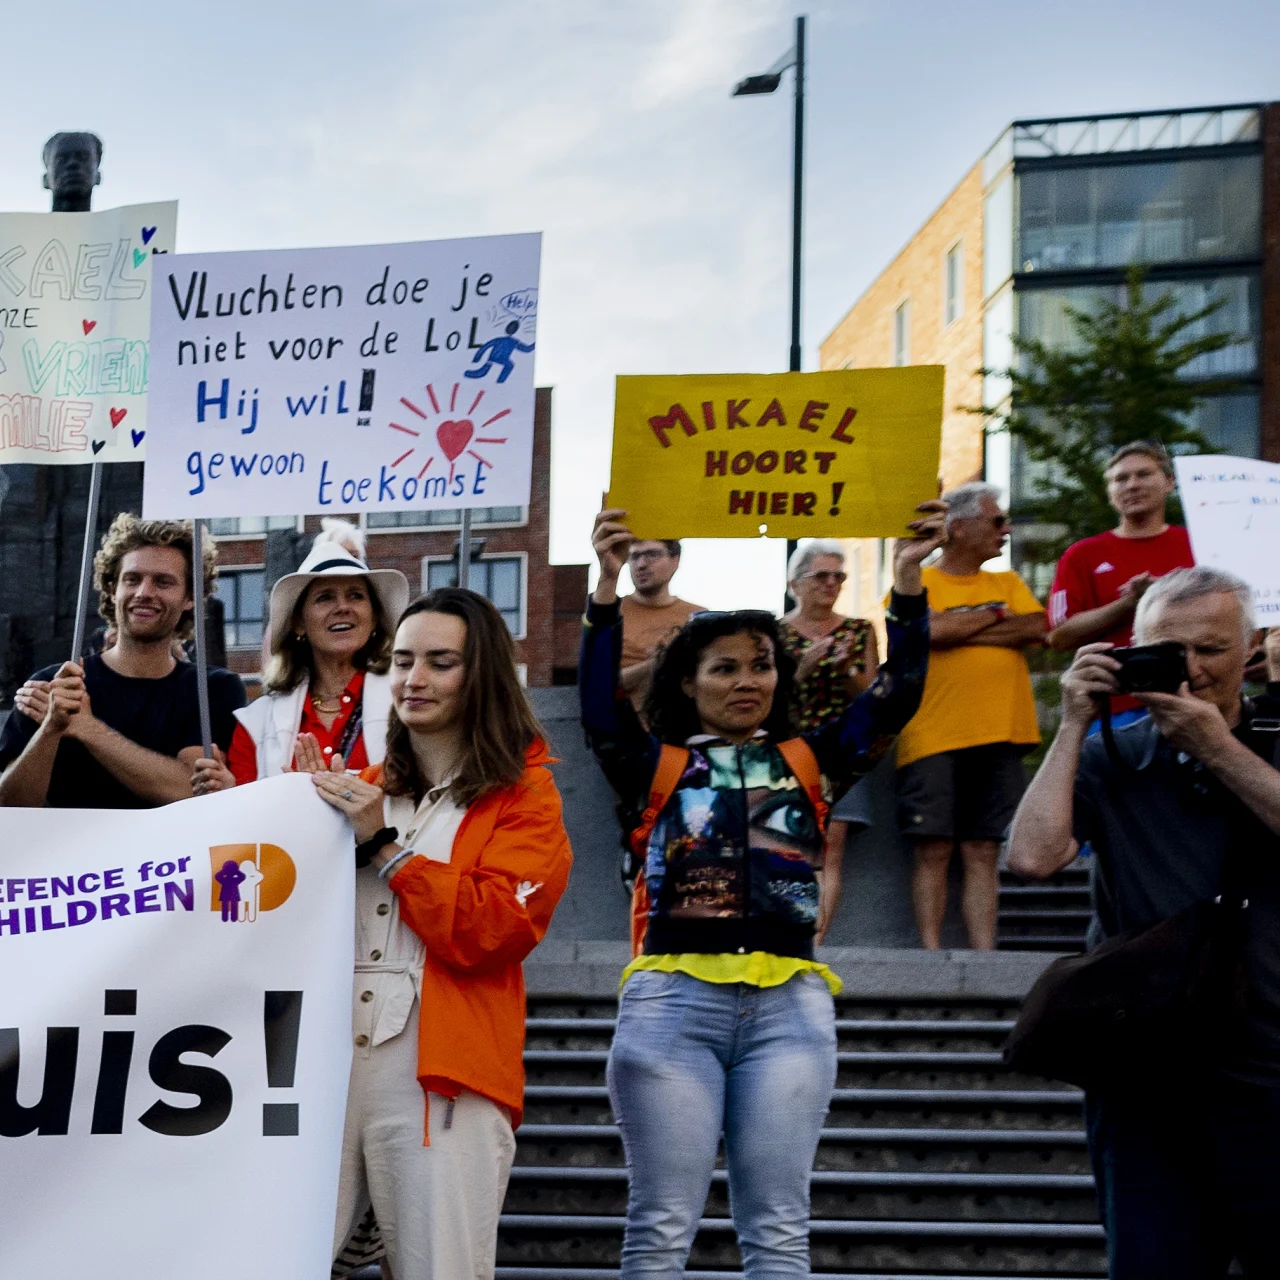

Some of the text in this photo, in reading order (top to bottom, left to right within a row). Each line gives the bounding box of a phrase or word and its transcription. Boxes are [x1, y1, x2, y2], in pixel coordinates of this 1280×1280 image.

[366, 266, 429, 306] doe
[451, 263, 494, 312] je
[178, 331, 248, 366] niet
[268, 336, 345, 361] voor
[359, 321, 399, 358] de
[197, 378, 259, 435] Hij
[647, 397, 858, 448] MIKAEL
[187, 449, 487, 506] gewoon toekomst
[704, 449, 838, 478] HOORT
[728, 489, 819, 517] HIER
[138, 855, 192, 883] for
